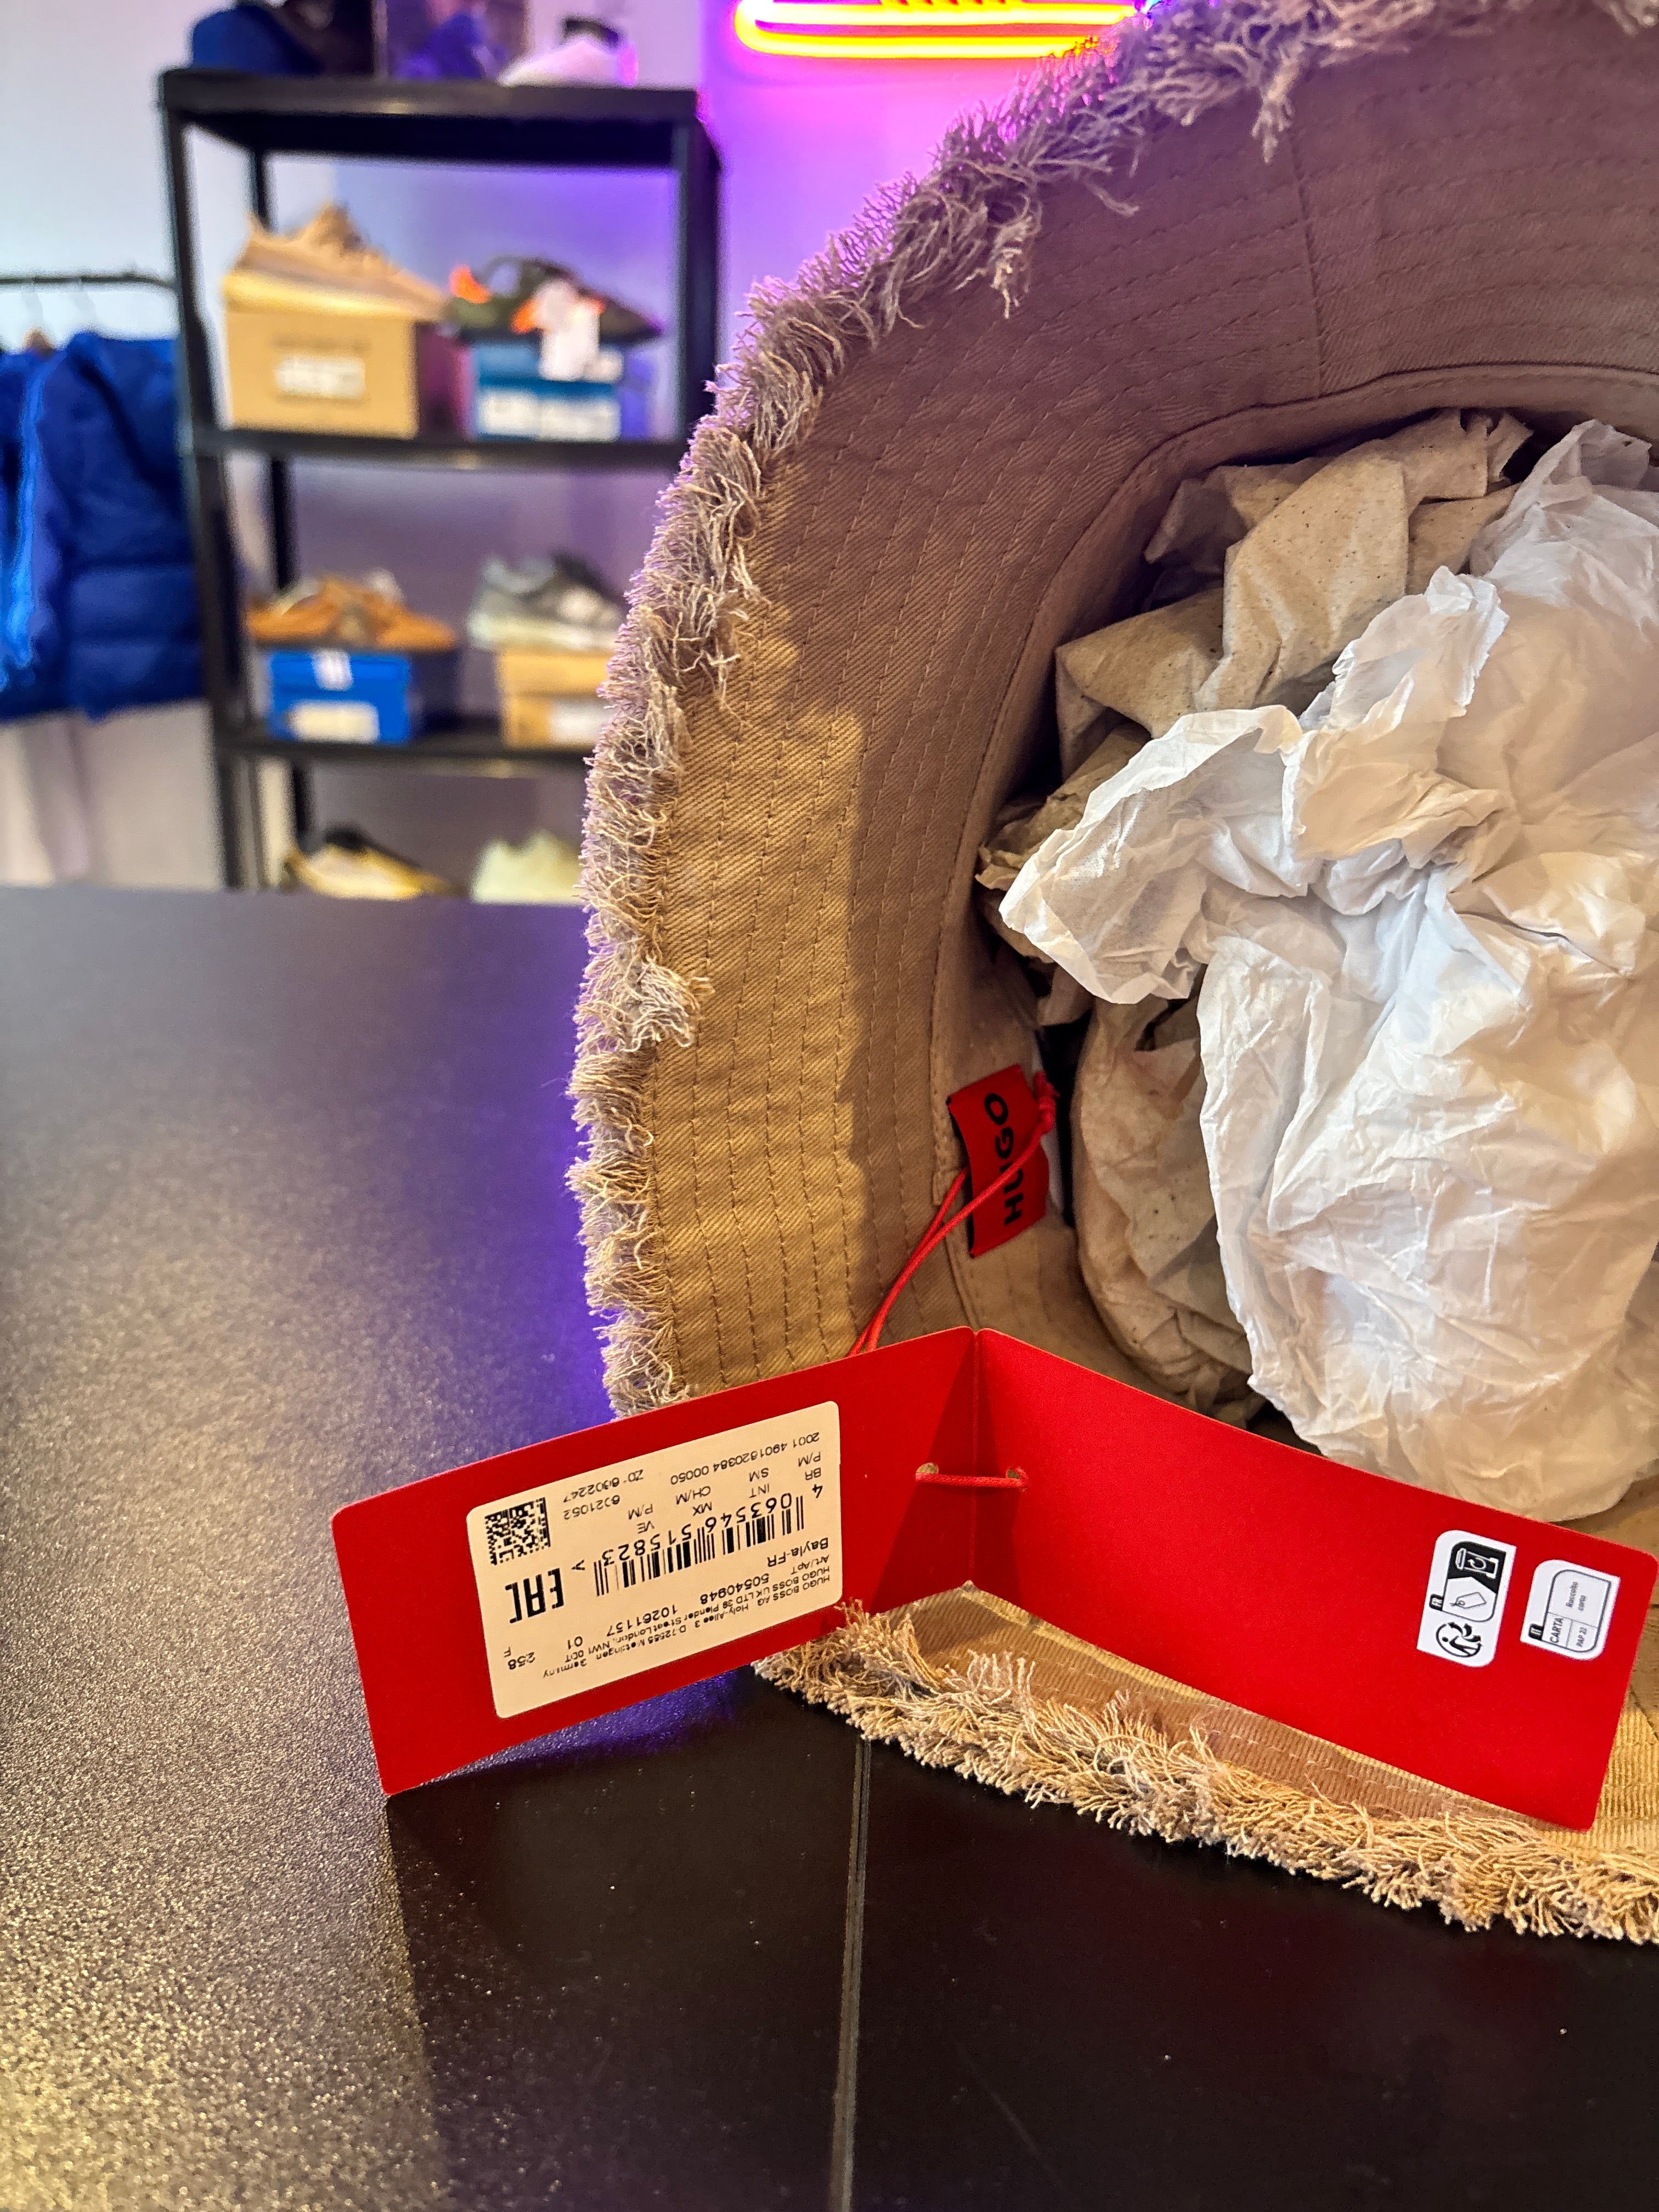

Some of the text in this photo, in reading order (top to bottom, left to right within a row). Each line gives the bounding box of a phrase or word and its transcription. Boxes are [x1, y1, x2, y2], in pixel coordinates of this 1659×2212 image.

[793, 1432, 819, 1448] 2001
[670, 1466, 709, 1485] 00050
[628, 1452, 821, 1520] P/M SM CH/M P/M
[636, 1468, 821, 1534] BR INT MX VE
[767, 1537, 828, 1567] Bayla-FR
[802, 1566, 830, 1581] HUGO
[700, 1573, 769, 1605] 50540948
[772, 1576, 799, 1592] BOSS
[803, 1575, 830, 1590] HUGO
[736, 1592, 754, 1604] LTD
[756, 1587, 770, 1598] UK
[757, 1595, 770, 1606] AG
[773, 1585, 799, 1601] BOSS
[607, 1605, 678, 1637] 10261157
[703, 1603, 748, 1623] Holy-Allee
[1549, 1616, 1563, 1644] CARTA
[567, 1636, 583, 1650] 01
[588, 1641, 610, 1654] NW1
[1575, 1634, 1585, 1647] PAP
[504, 1646, 511, 1657] F
